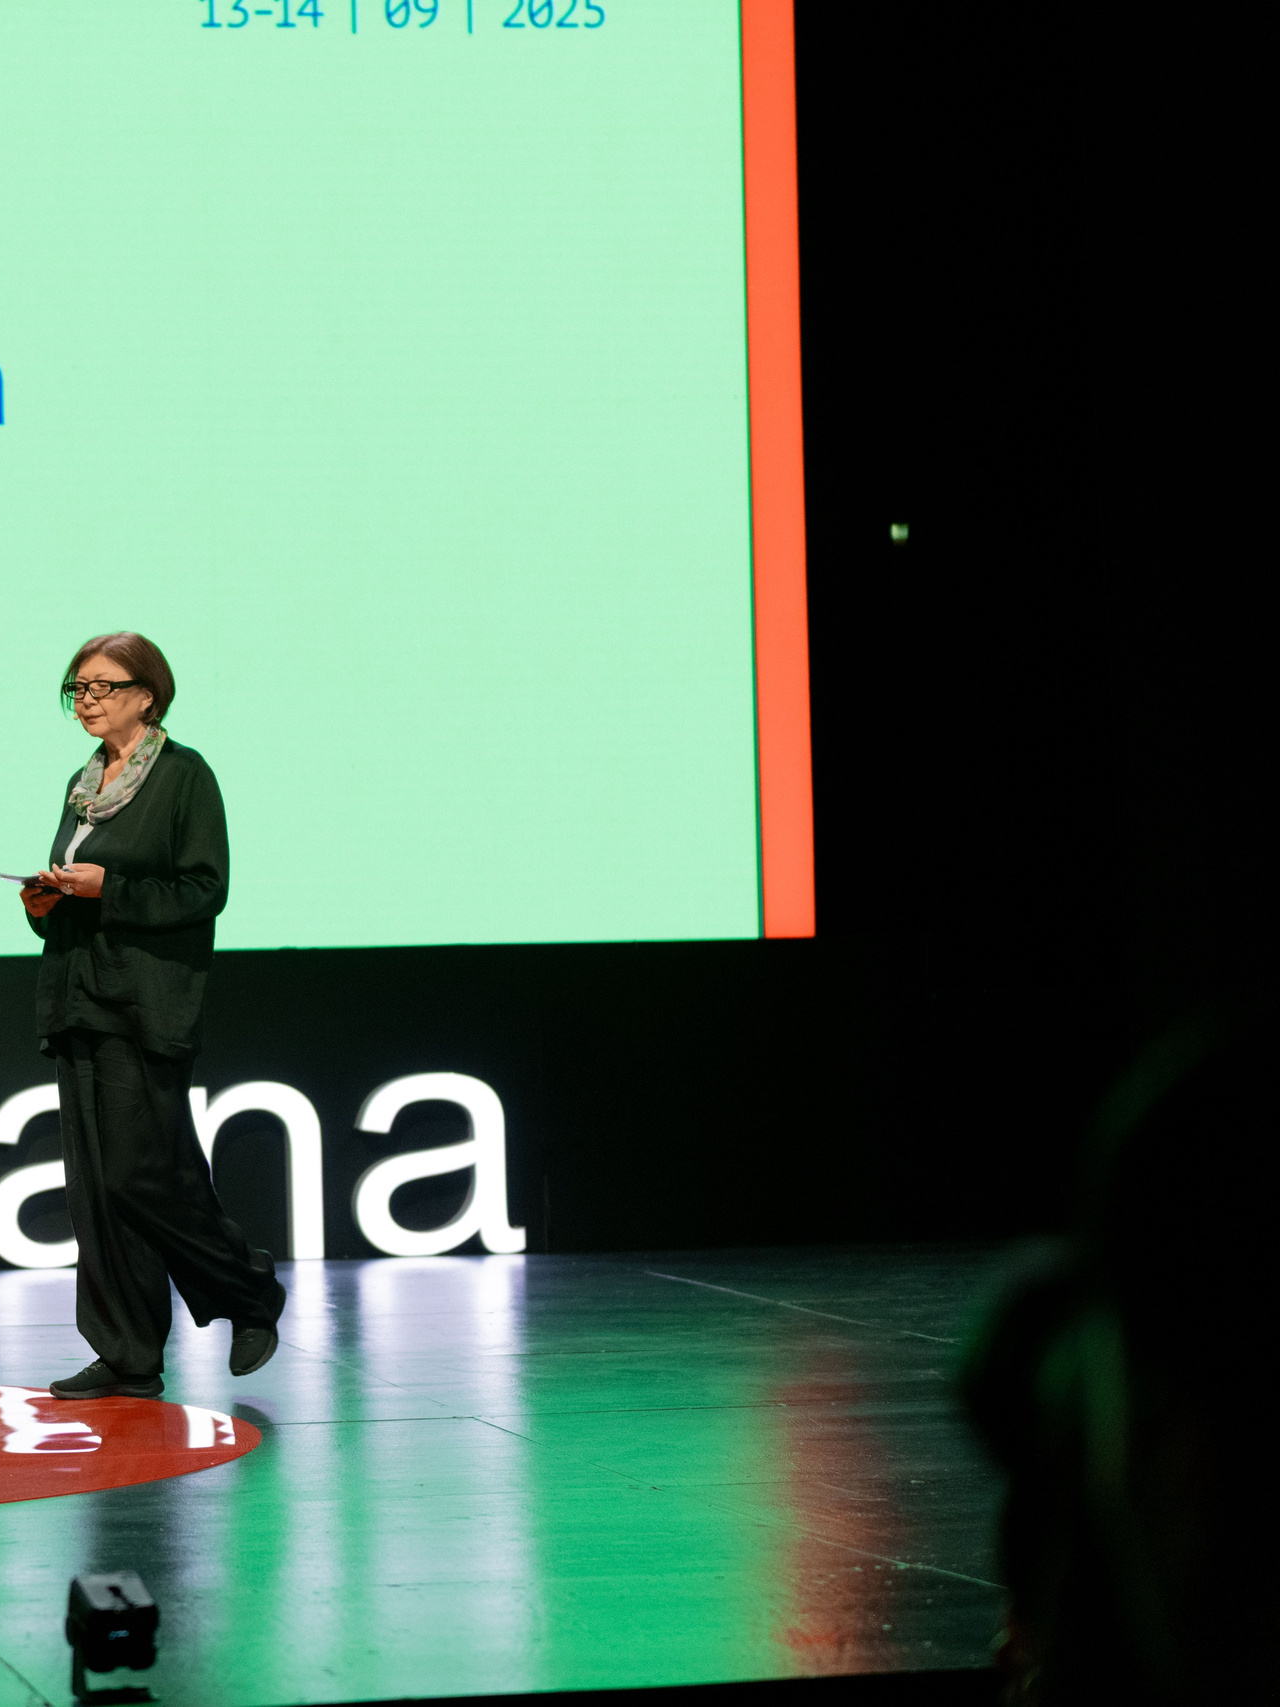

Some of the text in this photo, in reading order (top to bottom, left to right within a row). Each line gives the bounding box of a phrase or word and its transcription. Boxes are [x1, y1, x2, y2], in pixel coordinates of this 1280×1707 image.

[200, 0, 327, 30] 13-14
[384, 0, 441, 30] 09
[502, 0, 607, 30] 2025
